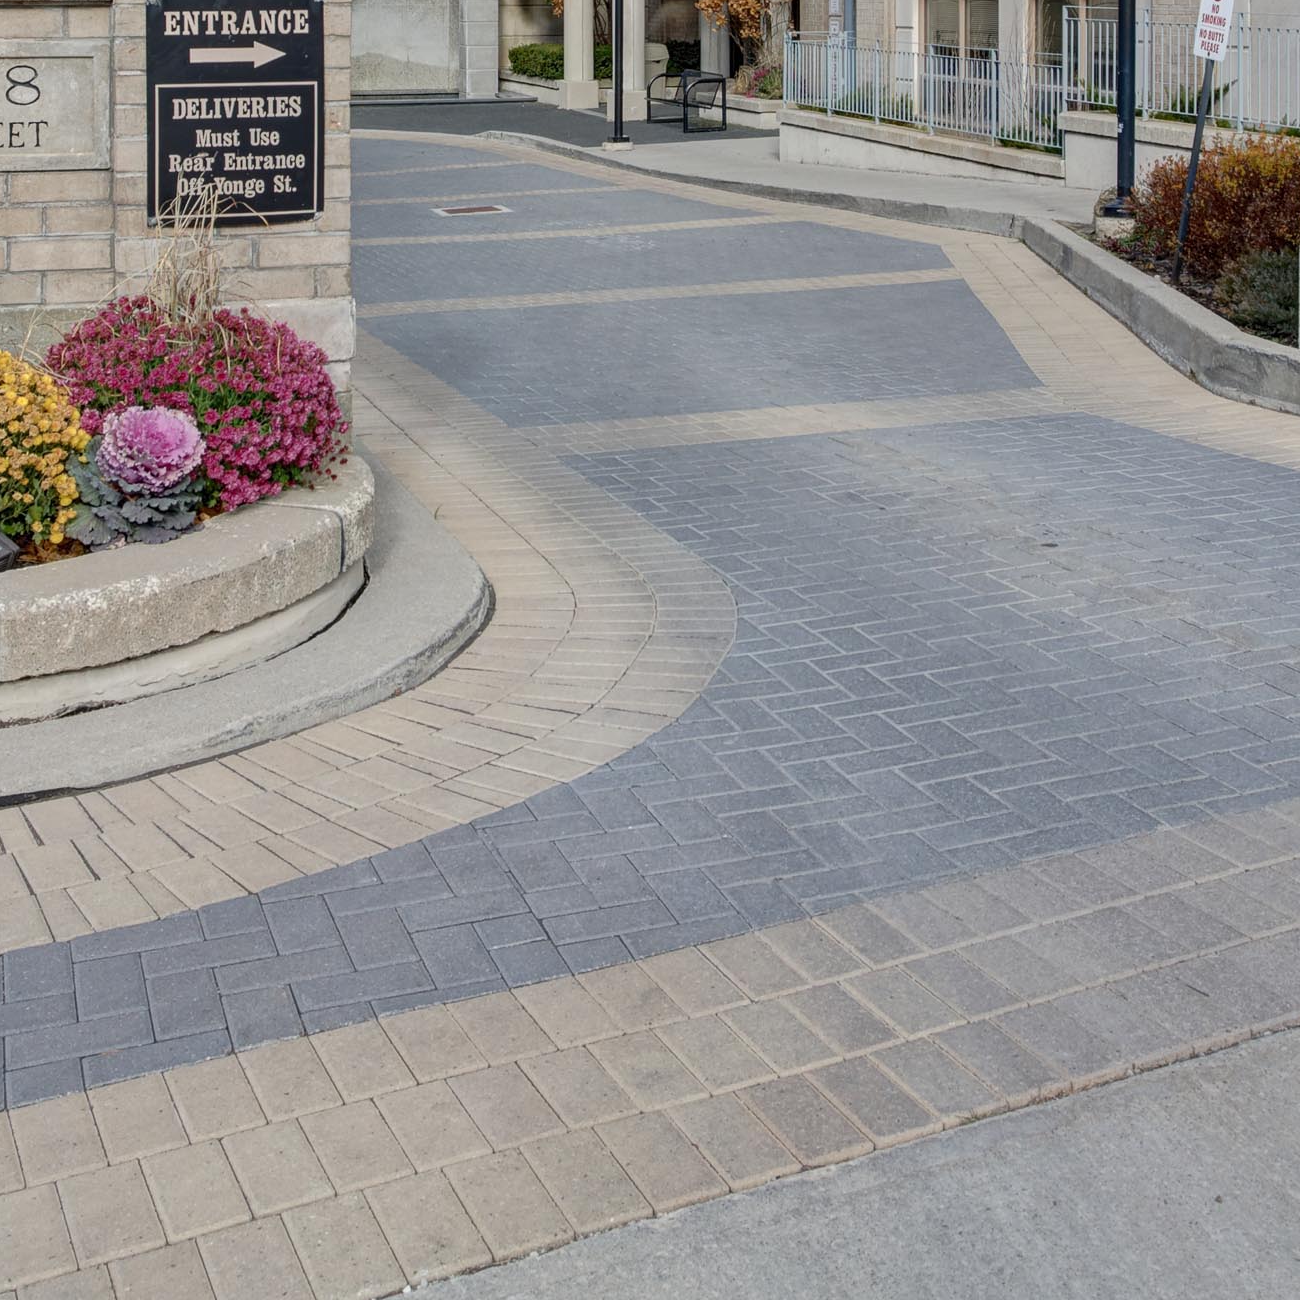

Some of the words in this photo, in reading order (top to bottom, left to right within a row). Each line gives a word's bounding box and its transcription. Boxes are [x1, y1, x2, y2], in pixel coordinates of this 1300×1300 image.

[1211, 3, 1220, 14] NO
[163, 9, 310, 36] ENTRANCE
[1201, 13, 1227, 27] SMOKING
[1199, 28, 1208, 39] NO
[1207, 30, 1224, 43] BUTTS
[1200, 40, 1220, 53] PLEASE
[172, 96, 302, 120] DELIVERIES
[196, 129, 240, 148] Must
[249, 128, 280, 146] Use
[168, 154, 215, 173] Rear
[223, 153, 306, 171] Entrance
[178, 177, 204, 197] Off
[213, 176, 265, 198] Yonge
[273, 175, 297, 193] St.
